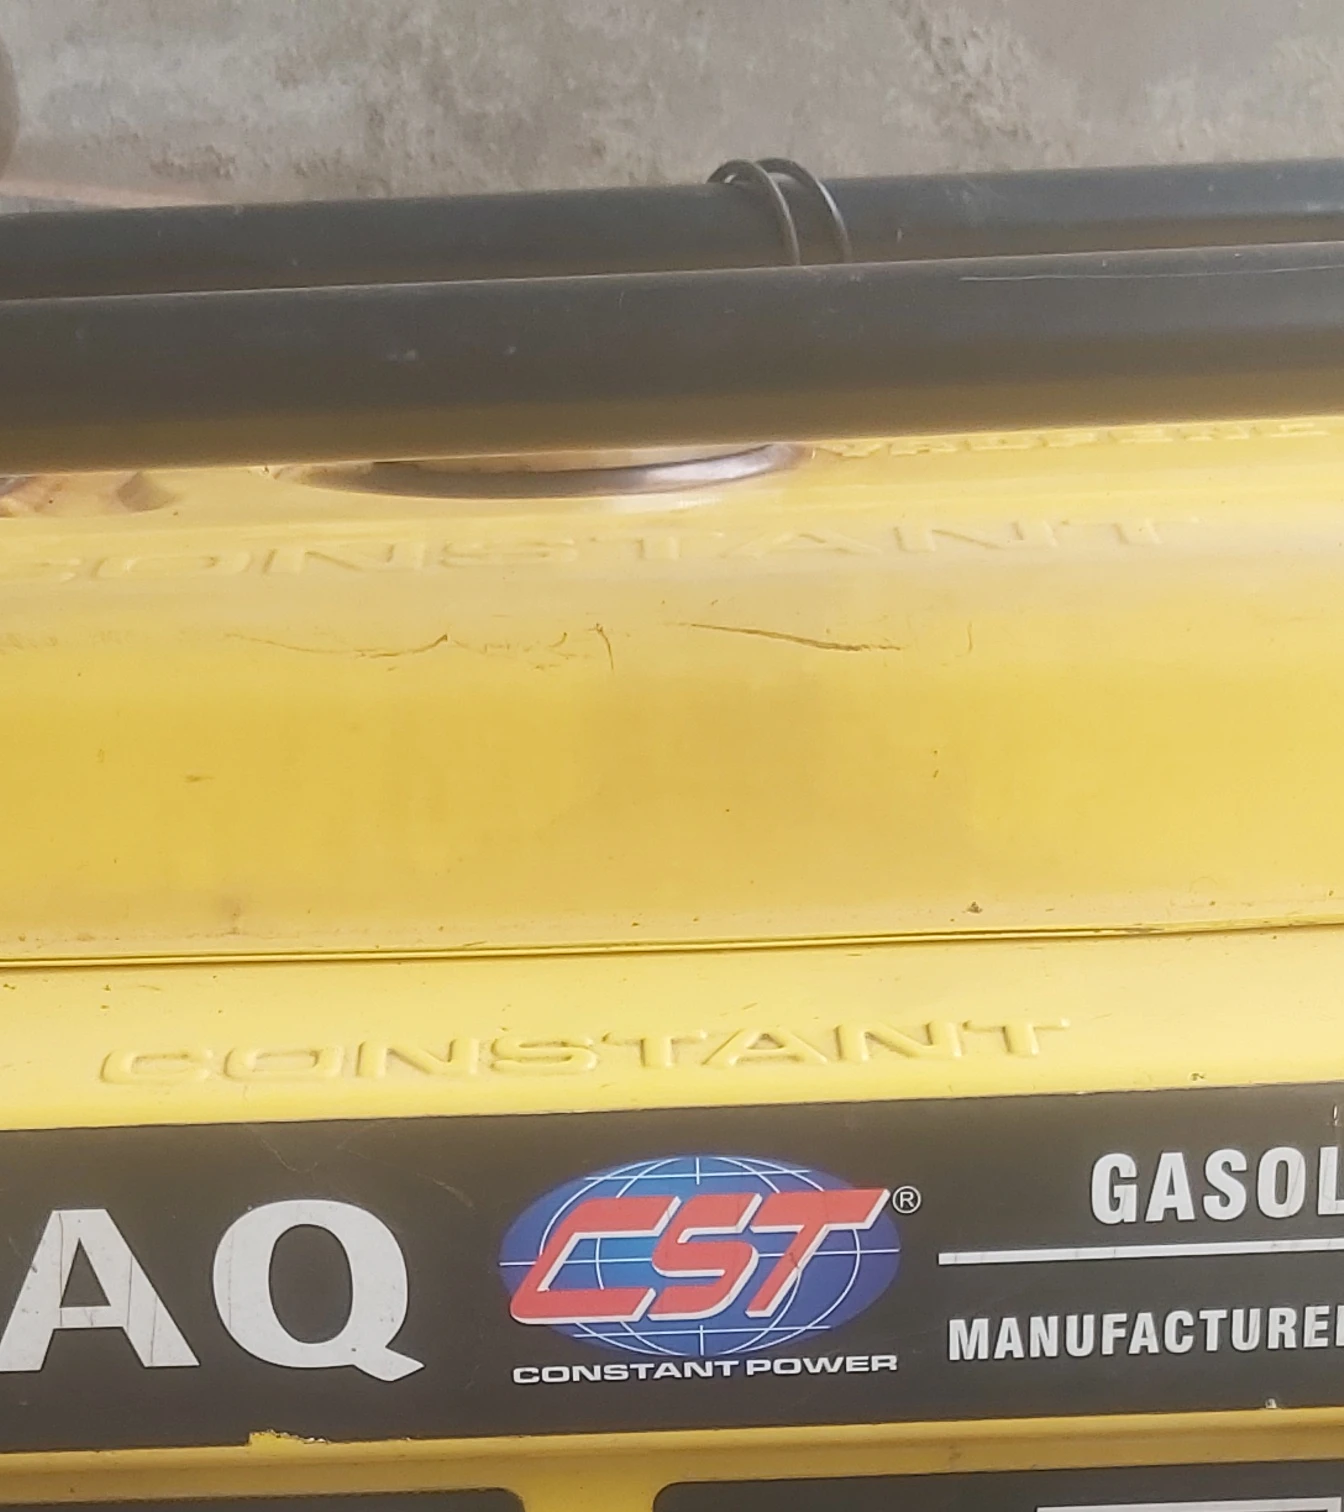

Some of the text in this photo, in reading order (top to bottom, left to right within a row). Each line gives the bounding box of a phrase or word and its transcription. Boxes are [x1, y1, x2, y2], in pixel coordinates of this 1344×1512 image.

[99, 1018, 1071, 1085] CONSTANT
[510, 1189, 891, 1326] CST
[512, 1354, 899, 1385] CONSTANT POWER
